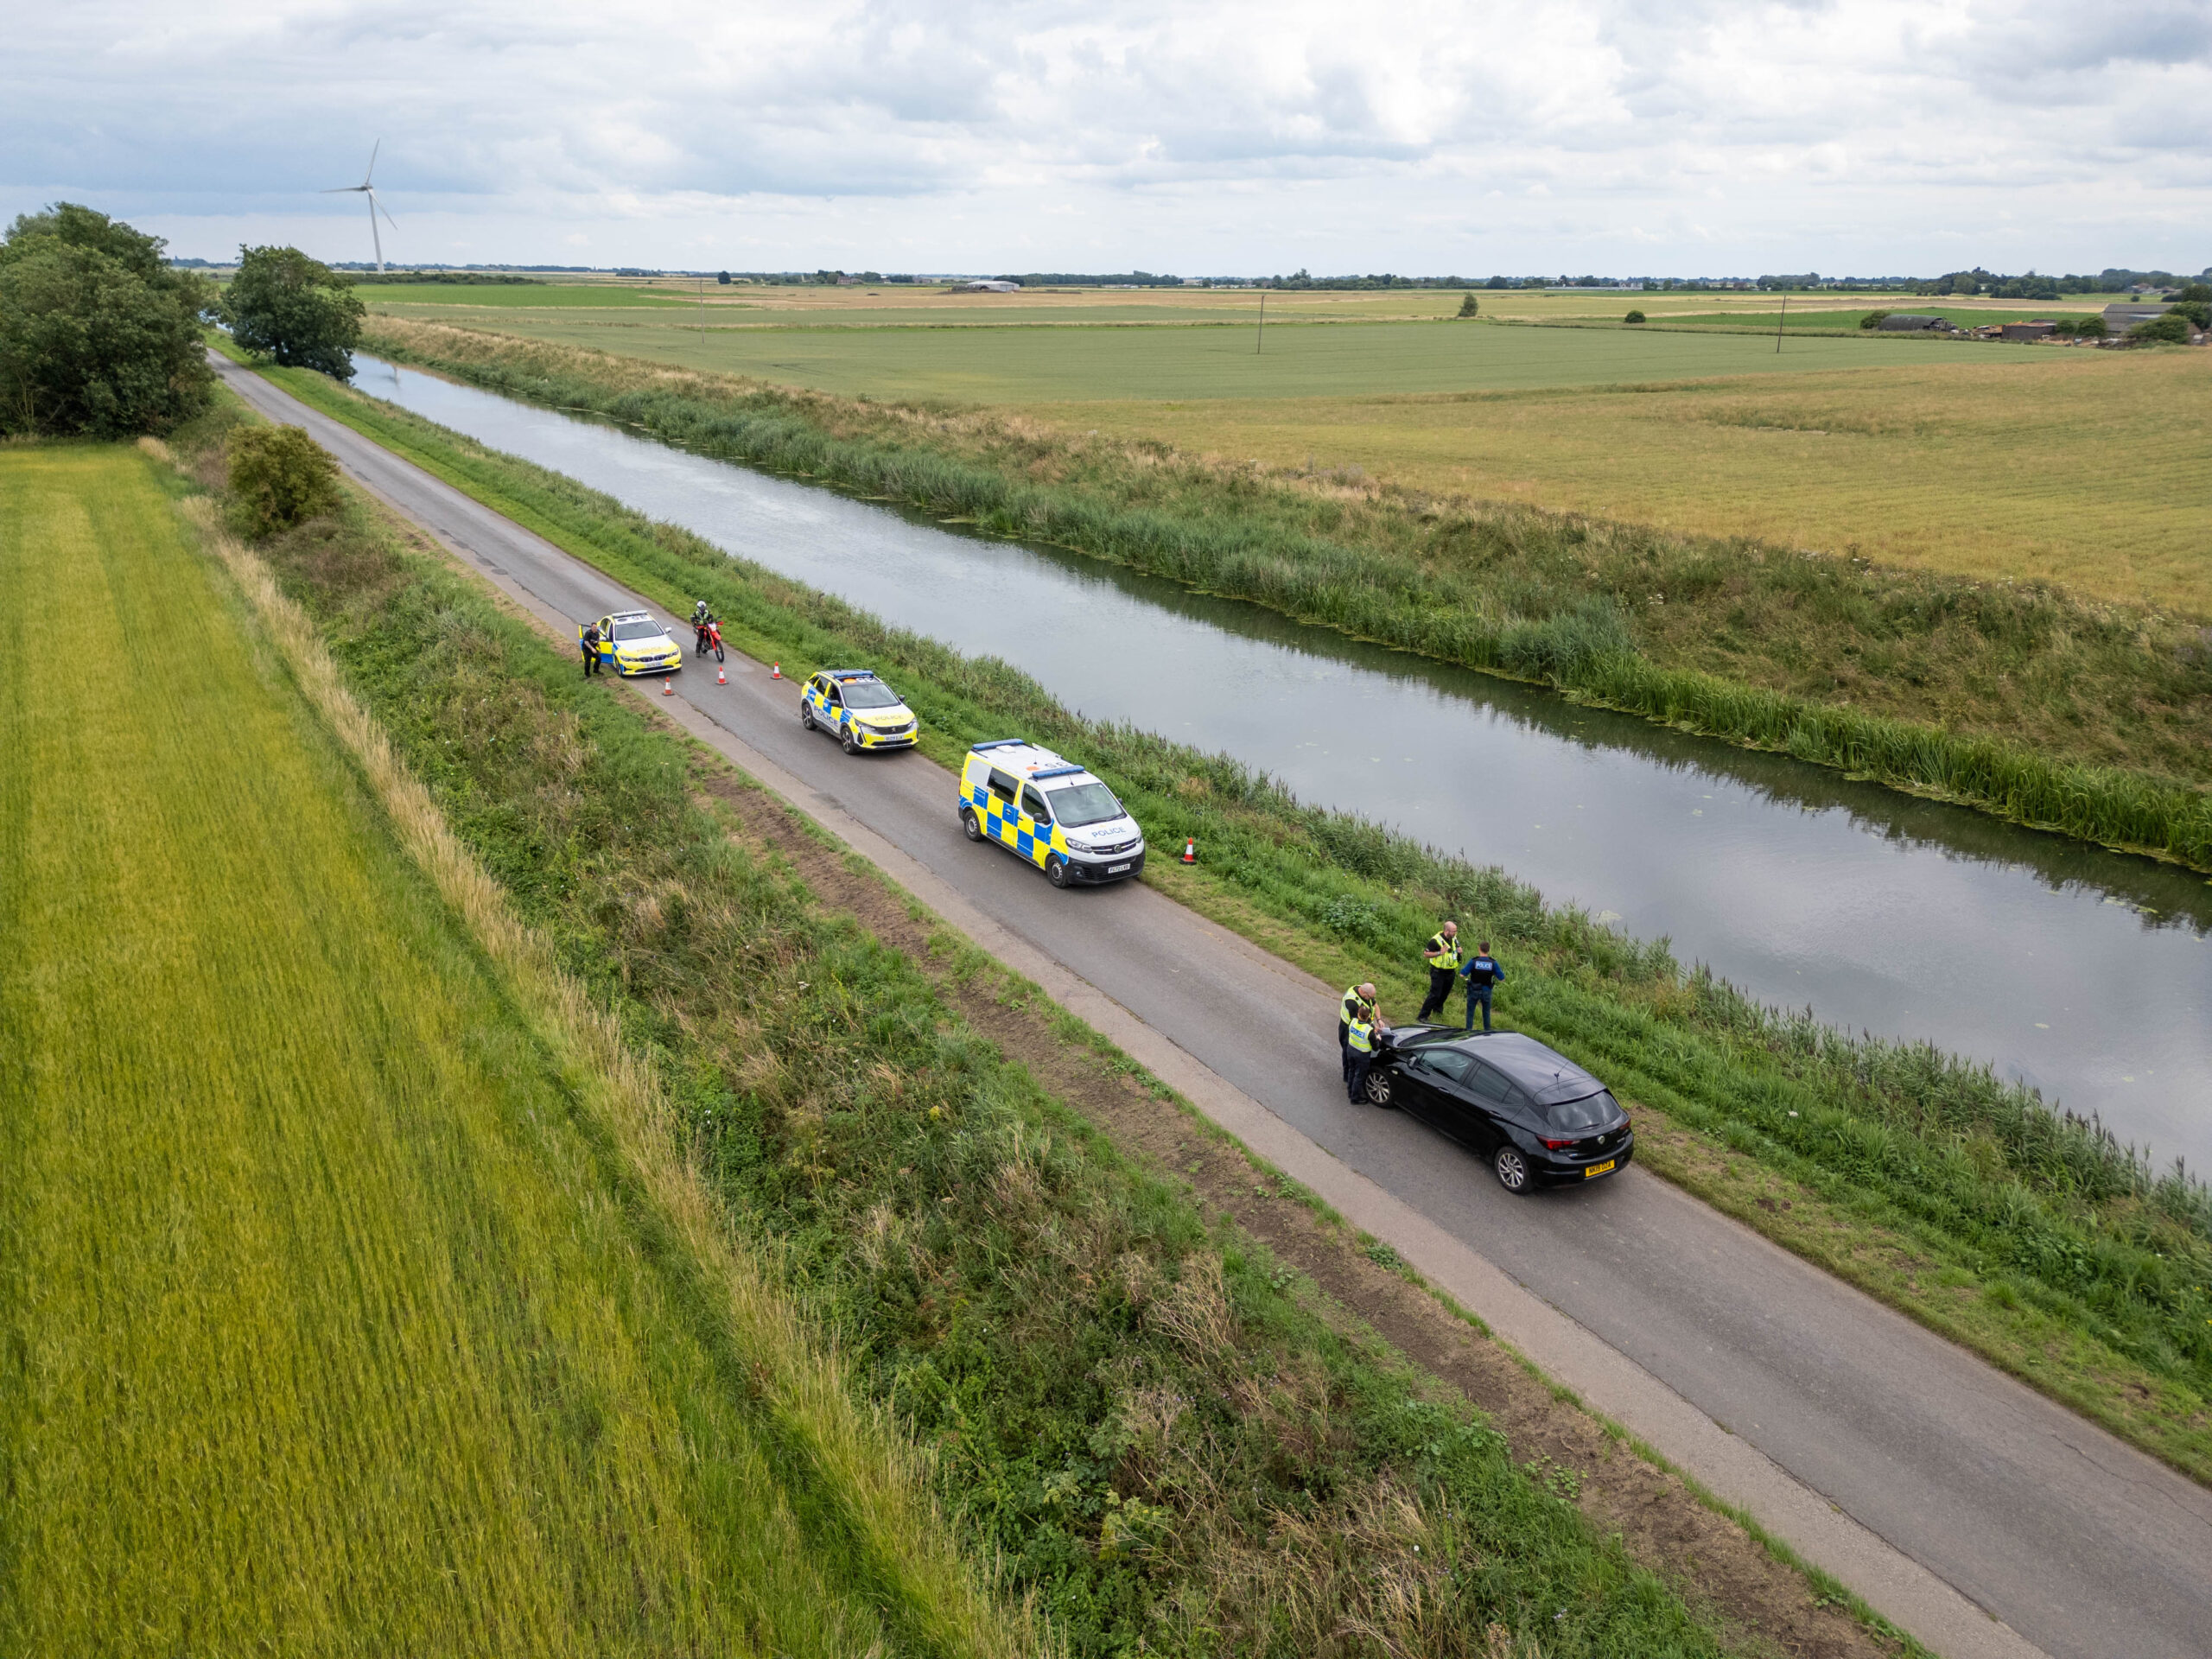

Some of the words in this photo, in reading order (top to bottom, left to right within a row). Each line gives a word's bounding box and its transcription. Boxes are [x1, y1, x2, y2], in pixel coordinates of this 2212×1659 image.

[814, 705, 838, 727] POLICE
[1091, 827, 1126, 838] POLICE
[1350, 1027, 1365, 1039] POLICE
